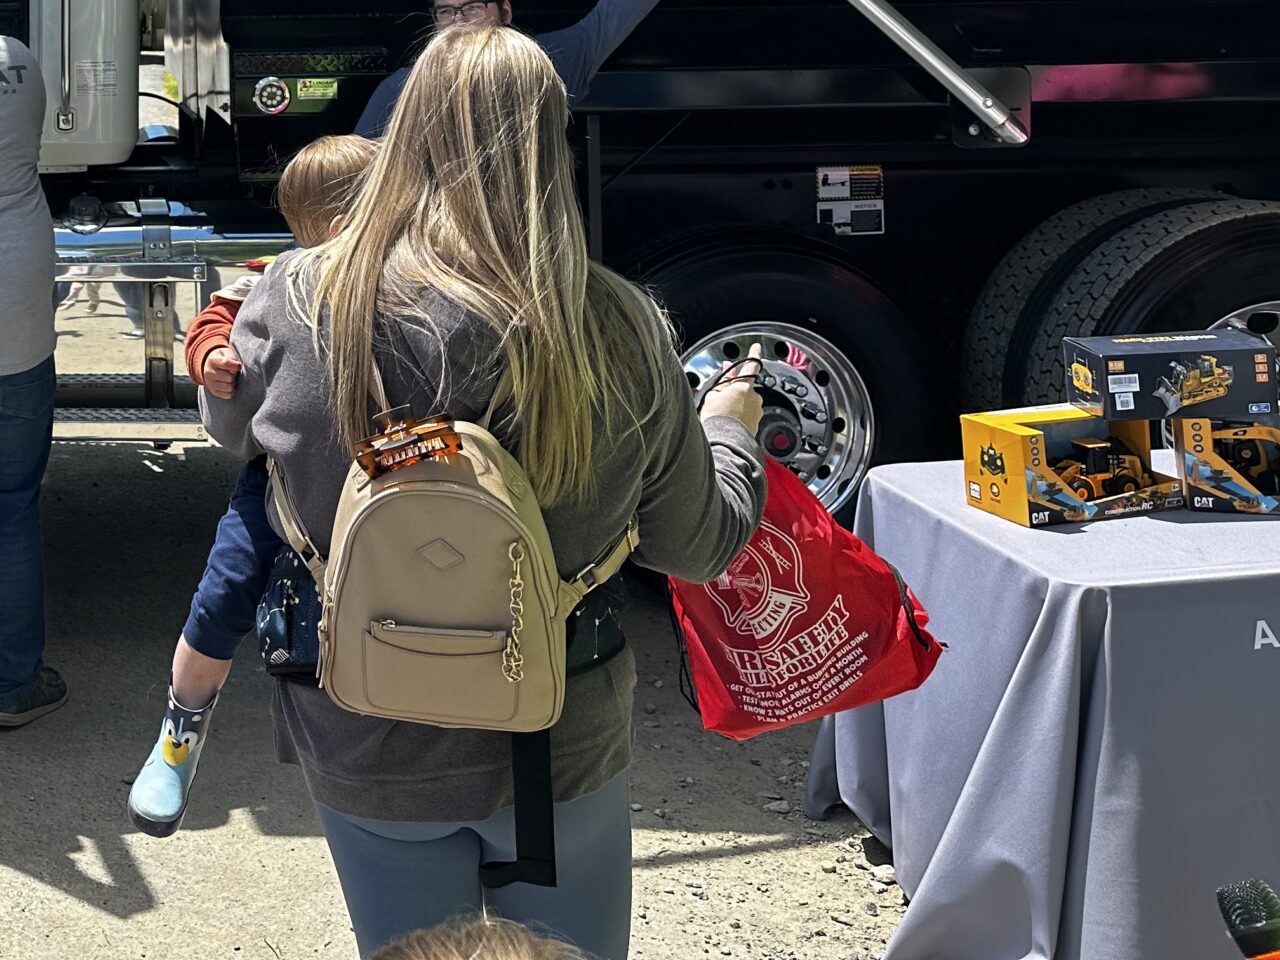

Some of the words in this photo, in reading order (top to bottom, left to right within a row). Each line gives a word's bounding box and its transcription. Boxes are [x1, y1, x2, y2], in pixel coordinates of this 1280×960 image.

[1032, 511, 1050, 524] CAT
[1141, 501, 1154, 510] RC
[1193, 496, 1214, 508] CAT
[752, 600, 787, 636] ECTING
[763, 594, 850, 672] SAFETY
[730, 683, 744, 692] GET
[787, 681, 800, 691] OF
[800, 678, 807, 686] A
[806, 656, 837, 682] BURNING
[835, 631, 869, 658] BUILDING
[742, 695, 758, 705] TEST
[781, 686, 812, 706] ALARMS
[829, 667, 837, 675] A
[835, 647, 864, 669] MONTH
[772, 652, 817, 685] FOR
[812, 625, 849, 663] LIFE
[743, 704, 766, 715] KNOW
[767, 708, 773, 716] 2
[774, 704, 794, 716] WAYS
[794, 696, 813, 708] OUT
[821, 672, 845, 692] EVERY
[843, 654, 869, 675] ROOM
[756, 715, 779, 723] PLAN
[786, 700, 824, 721] PRACTICE
[823, 688, 840, 703] EXIT
[838, 671, 864, 692] DRILLS
